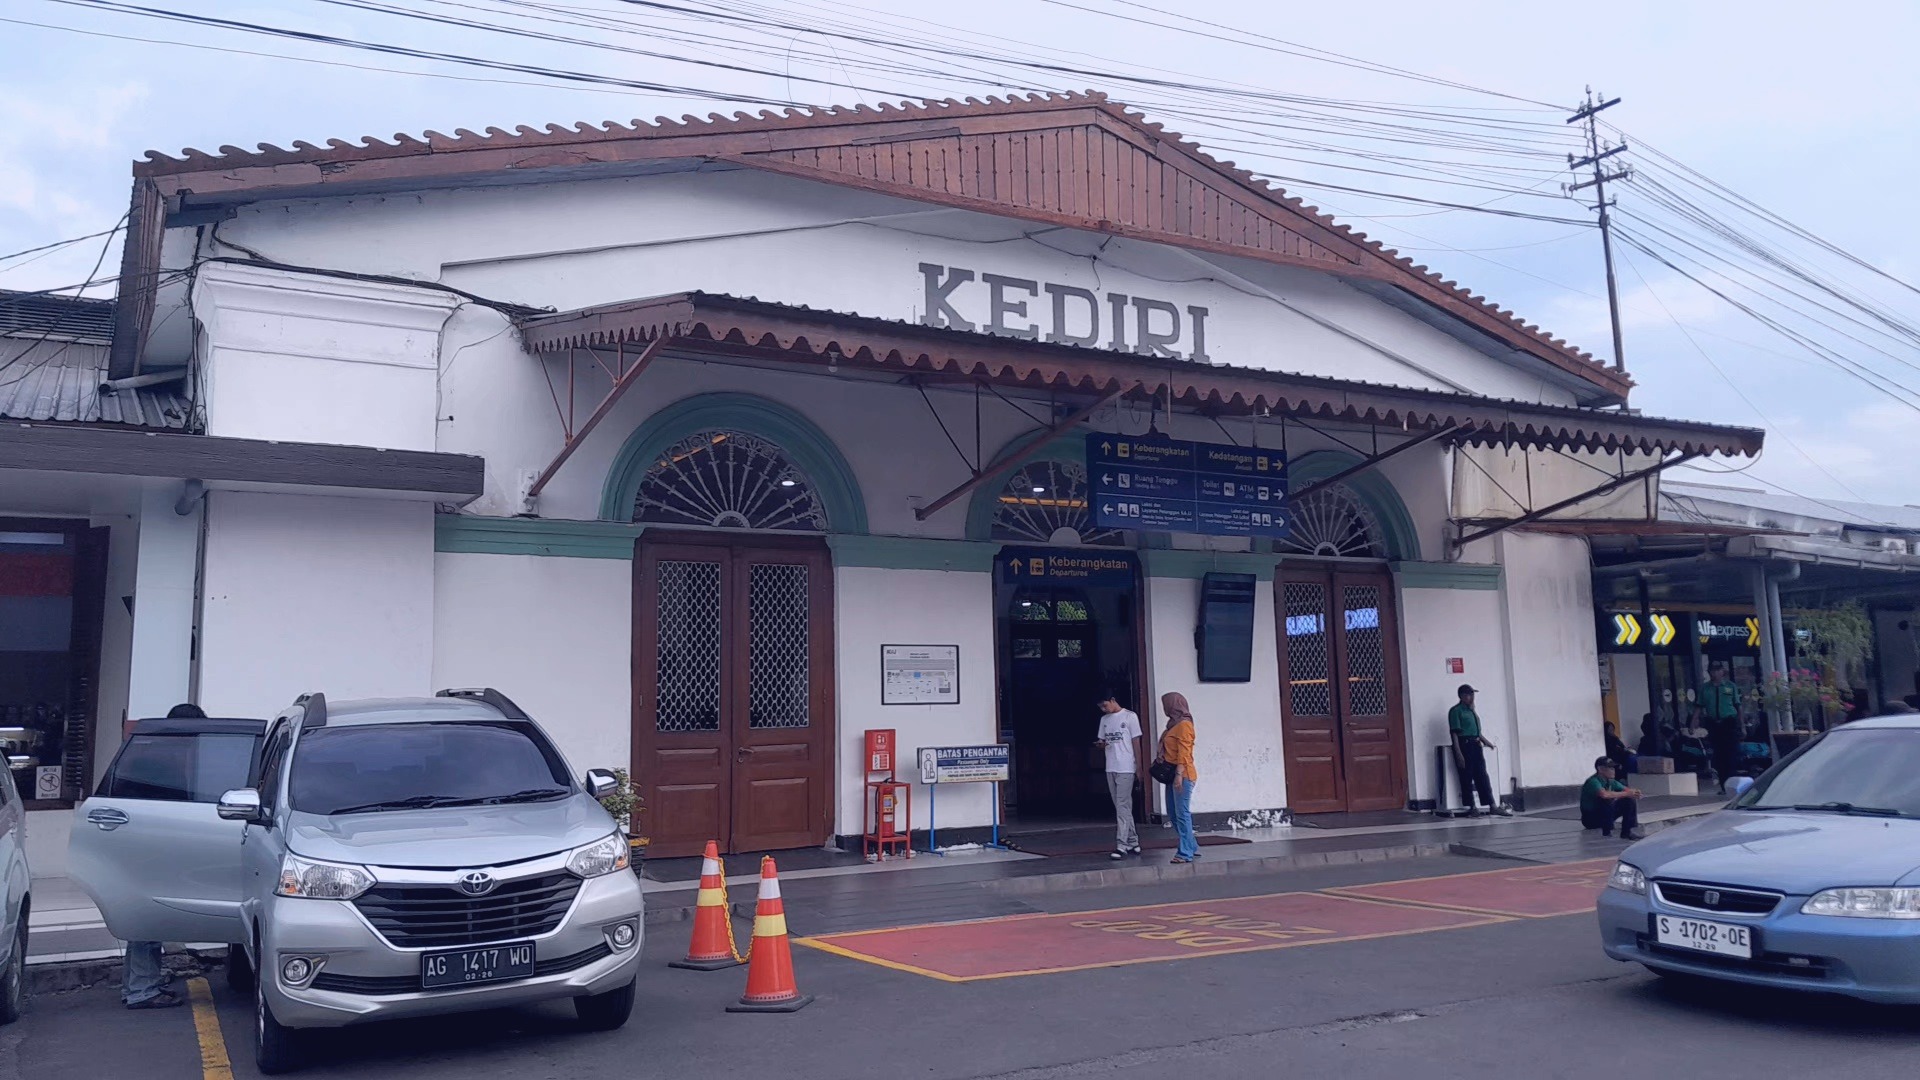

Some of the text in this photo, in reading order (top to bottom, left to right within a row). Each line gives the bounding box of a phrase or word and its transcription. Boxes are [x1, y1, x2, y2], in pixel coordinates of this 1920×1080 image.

[919, 262, 1210, 362] KEDIRI
[1134, 442, 1190, 456] Keberangkatan
[1208, 450, 1252, 464] Kedatangan
[1134, 474, 1178, 485] Ruang Tunggu
[1239, 484, 1254, 492] ATM
[1049, 556, 1128, 570] Keberangkatan
[1050, 568, 1088, 576] Departures
[937, 747, 1008, 758] BATAS PENGANTAR
[1661, 917, 1670, 934] S
[1681, 920, 1718, 942] 1702
[427, 956, 447, 977] AG
[462, 949, 499, 972] 1417
